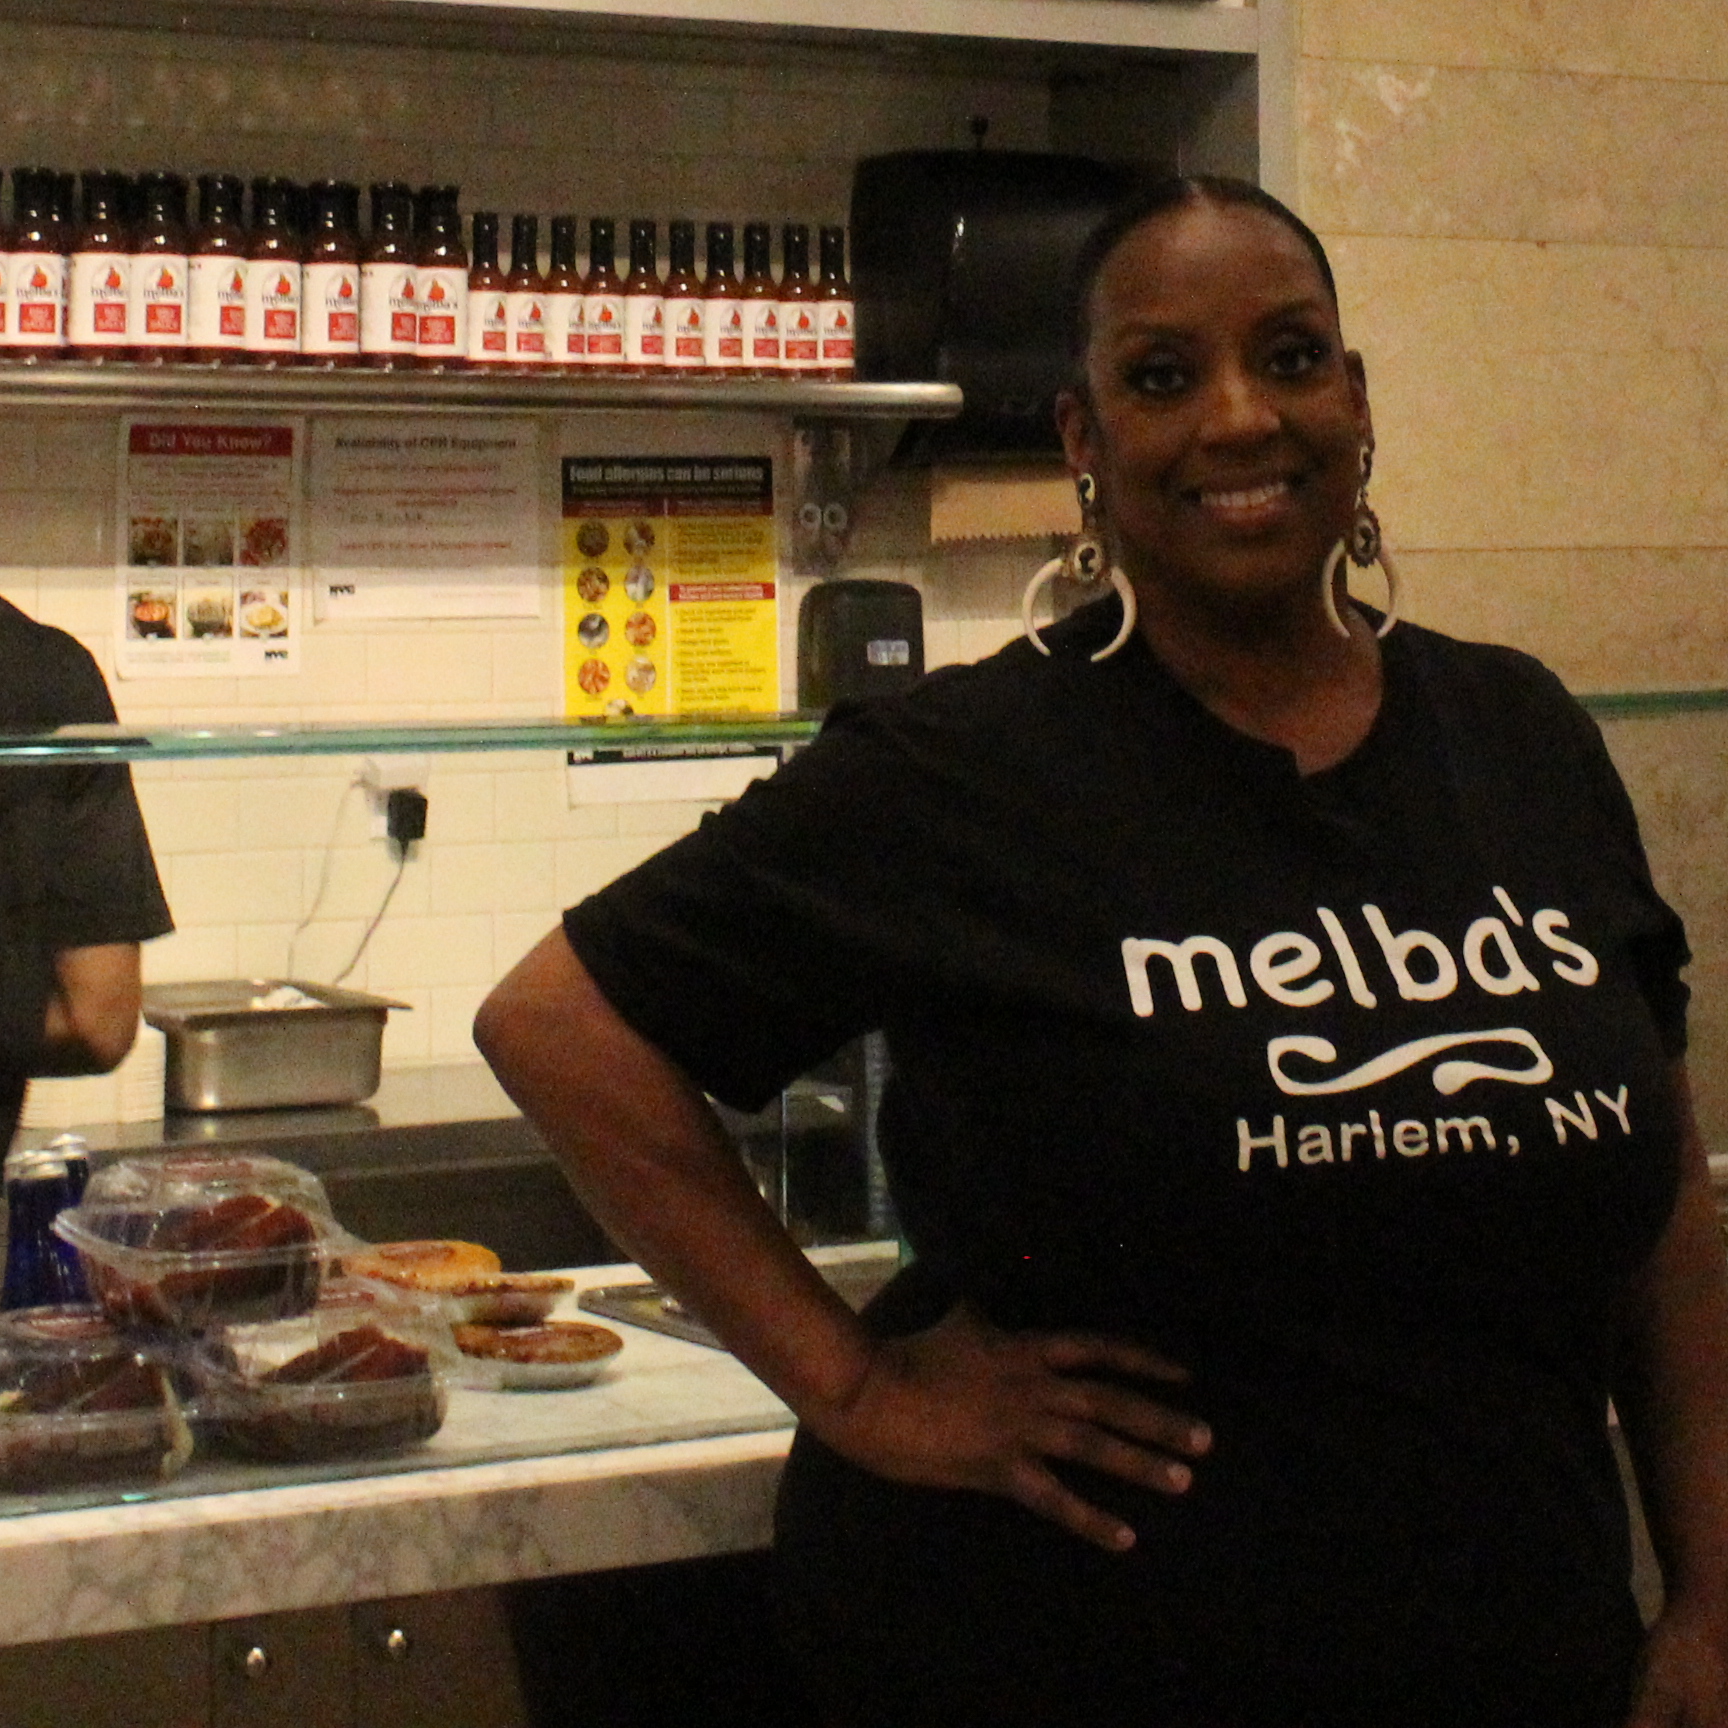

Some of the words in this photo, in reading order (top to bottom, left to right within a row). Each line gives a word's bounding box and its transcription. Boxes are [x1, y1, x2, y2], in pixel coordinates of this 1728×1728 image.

[1121, 885, 1600, 1018] melba's
[1236, 1109, 1520, 1172] Harlem,
[1544, 1084, 1632, 1146] NY
